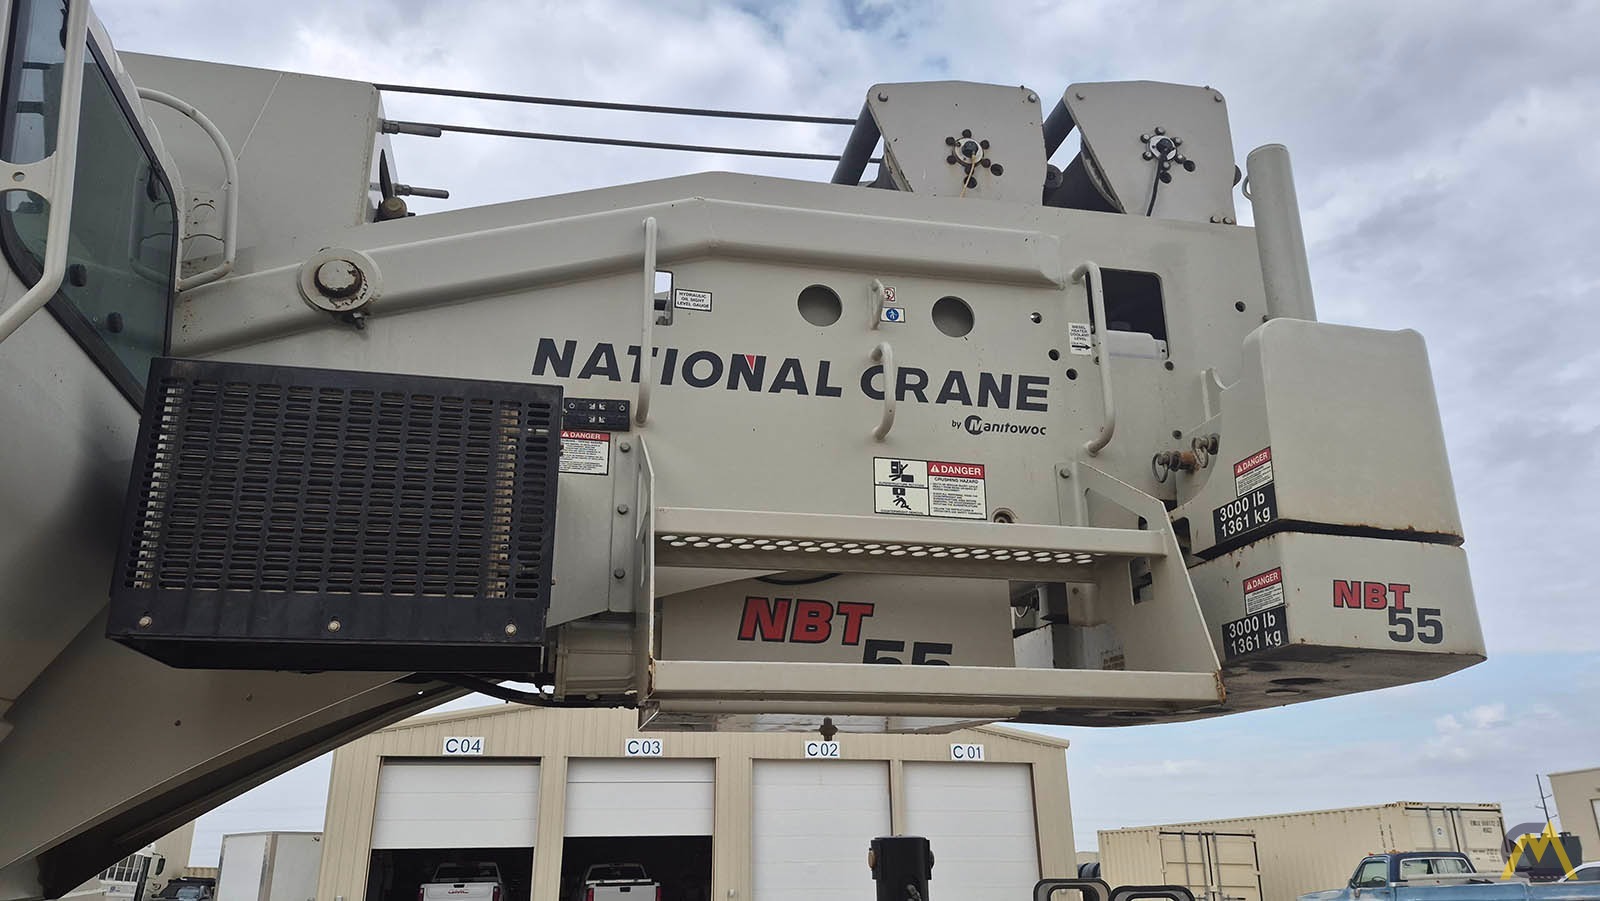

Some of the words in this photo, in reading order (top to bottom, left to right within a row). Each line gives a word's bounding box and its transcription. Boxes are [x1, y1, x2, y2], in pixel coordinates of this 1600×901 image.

[531, 338, 842, 398] NATIONAL
[860, 365, 1050, 412] CRANE
[570, 432, 601, 440] DANGER
[951, 420, 962, 429] by
[964, 415, 1047, 436] Manitowoc
[941, 465, 981, 476] DANGER
[1242, 451, 1268, 471] DANGER
[1220, 497, 1249, 522] 3000
[1252, 491, 1265, 508] lb
[1221, 513, 1249, 537] 1361
[1254, 506, 1271, 524] kg
[1252, 572, 1279, 588] DANGER
[1333, 579, 1411, 610] NBT
[737, 596, 875, 646] NBT
[1229, 616, 1260, 638] 3000
[1262, 612, 1276, 629] lb
[1388, 606, 1443, 644] 55
[1231, 633, 1260, 656] 1361
[1264, 629, 1282, 647] kg
[446, 738, 481, 753] C04
